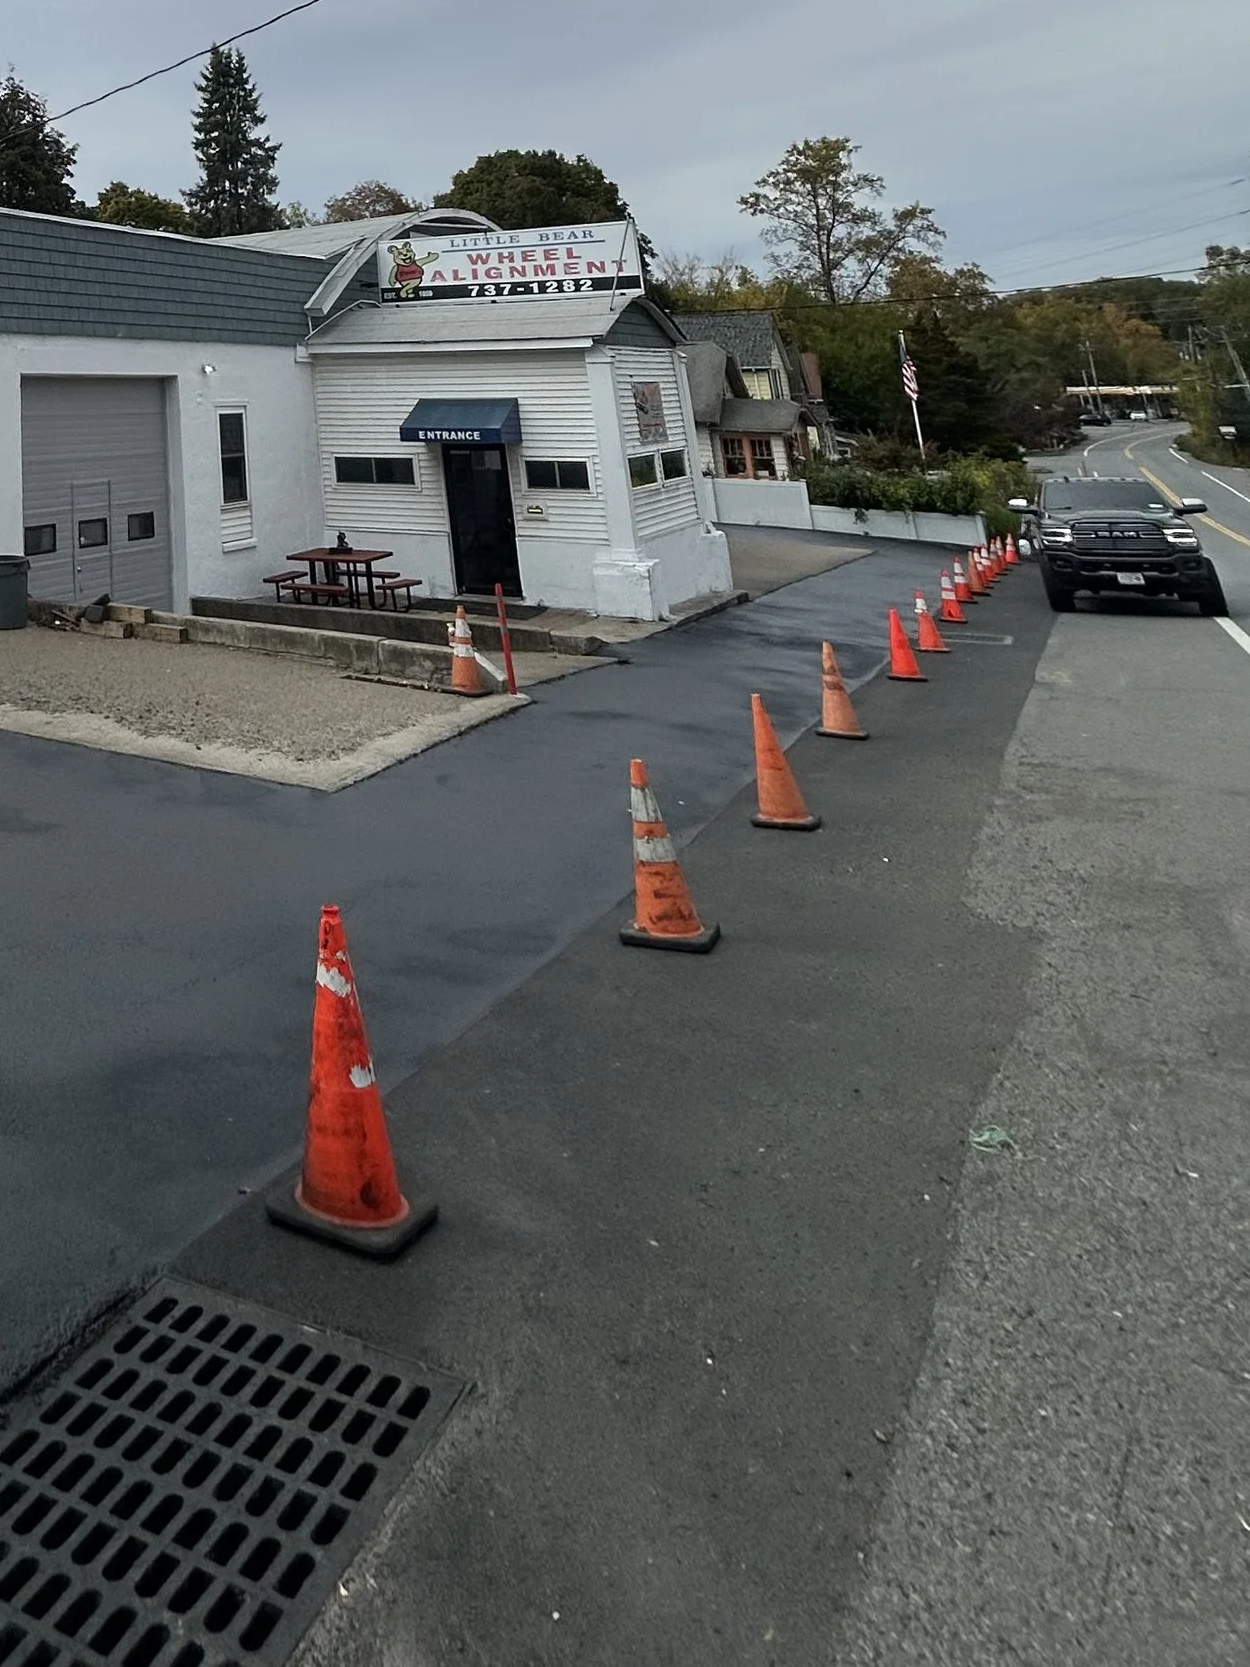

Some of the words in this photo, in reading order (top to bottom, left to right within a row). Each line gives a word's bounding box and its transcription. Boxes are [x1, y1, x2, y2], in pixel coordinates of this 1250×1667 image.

[449, 234, 520, 248] LITTLE
[539, 229, 594, 242] BEAR
[466, 247, 582, 266] WHEEL
[430, 258, 627, 282] ALIGNMENT
[467, 279, 594, 297] 737-1282
[418, 430, 481, 440] ENTRANCE
